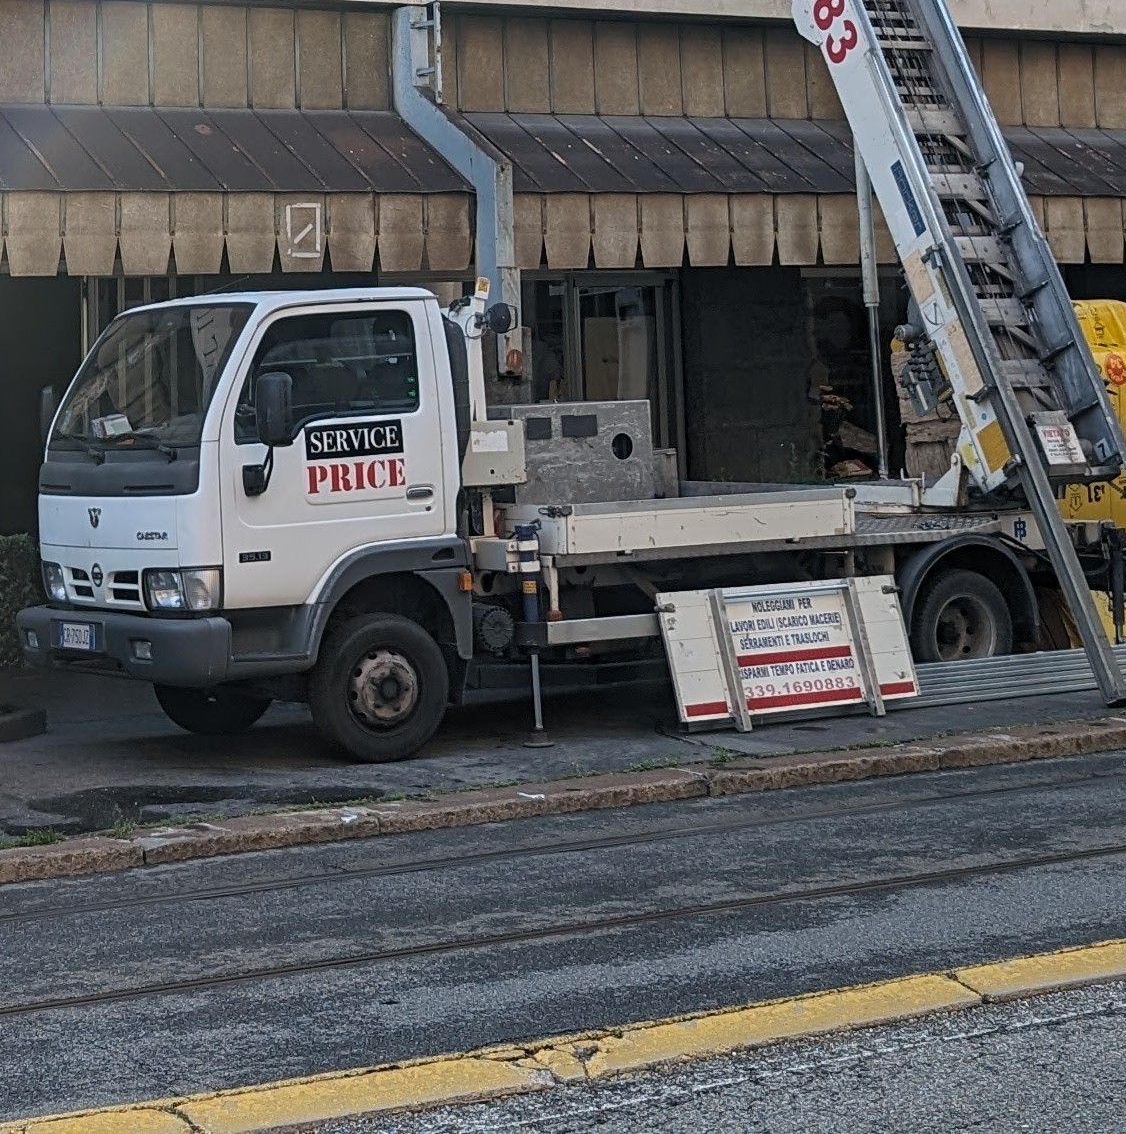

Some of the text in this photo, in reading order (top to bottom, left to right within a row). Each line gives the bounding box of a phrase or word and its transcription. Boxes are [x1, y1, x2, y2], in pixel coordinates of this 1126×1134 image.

[310, 426, 399, 454] SERVICE
[1098, 443, 1107, 458] 7
[307, 458, 406, 495] PRICE
[752, 597, 812, 613] NOLEGGIAMI PER
[730, 611, 841, 633] LAVORI EDILI (SCARICO MACERIE)
[740, 631, 830, 650] SERRAMENTI E TRASLOCHI
[740, 658, 855, 680] ISPARMI TEMPO FATICA E DENARO
[744, 676, 856, 698] 339.1690883
